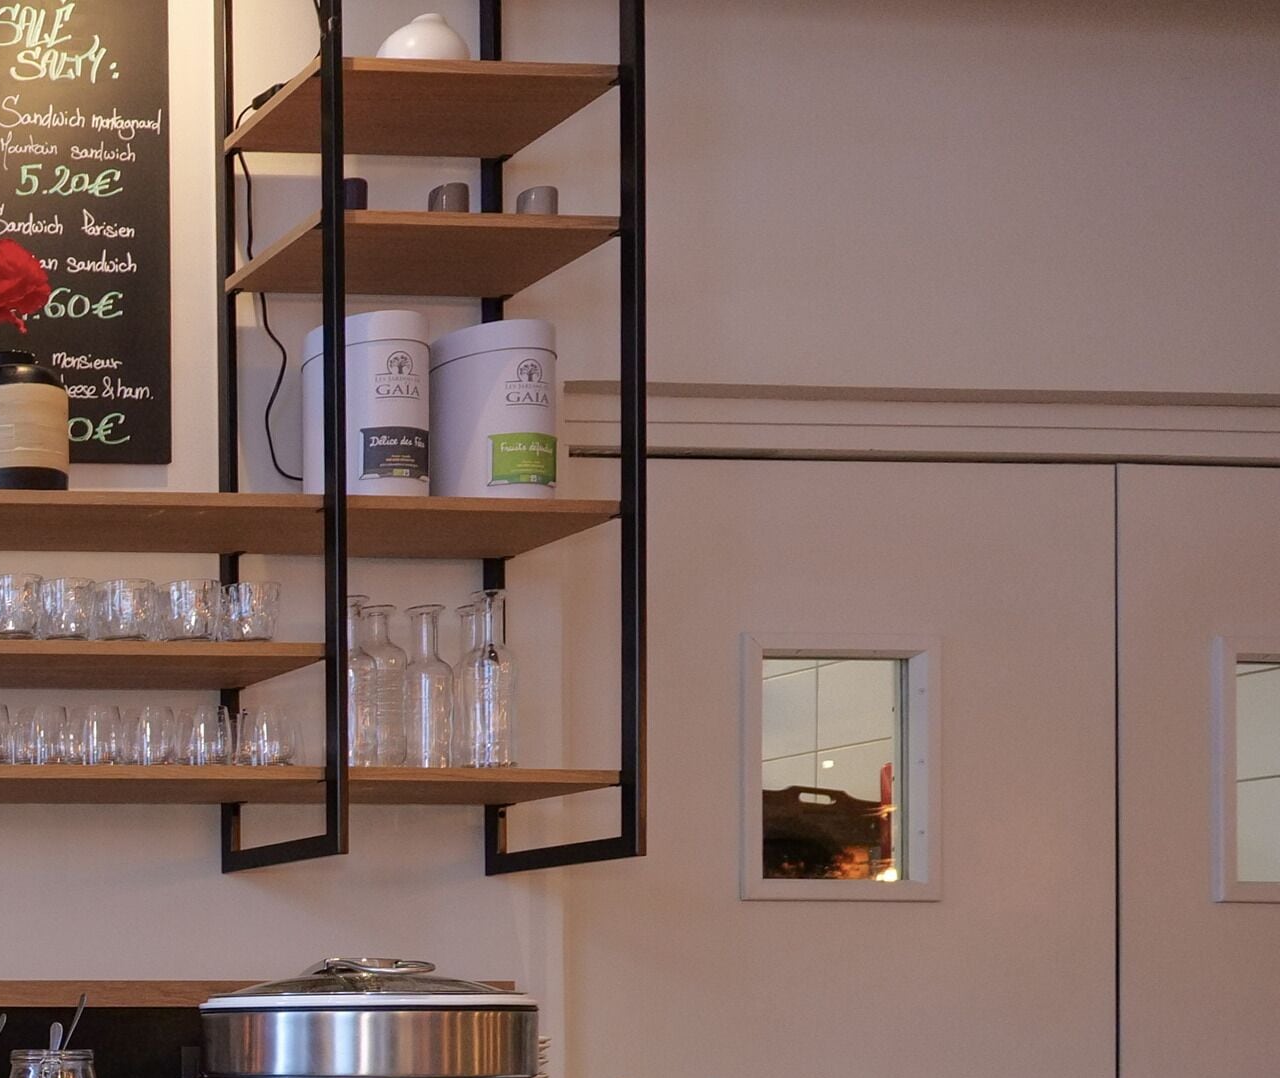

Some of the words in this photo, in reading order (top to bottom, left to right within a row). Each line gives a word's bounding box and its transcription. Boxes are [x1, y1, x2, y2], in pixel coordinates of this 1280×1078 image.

[0, 130, 59, 171] Mountain
[70, 141, 137, 163] sandwich
[15, 163, 124, 198] 5.20€
[80, 208, 137, 239] Parisien
[66, 248, 138, 274] sandwich
[101, 375, 116, 400] &
